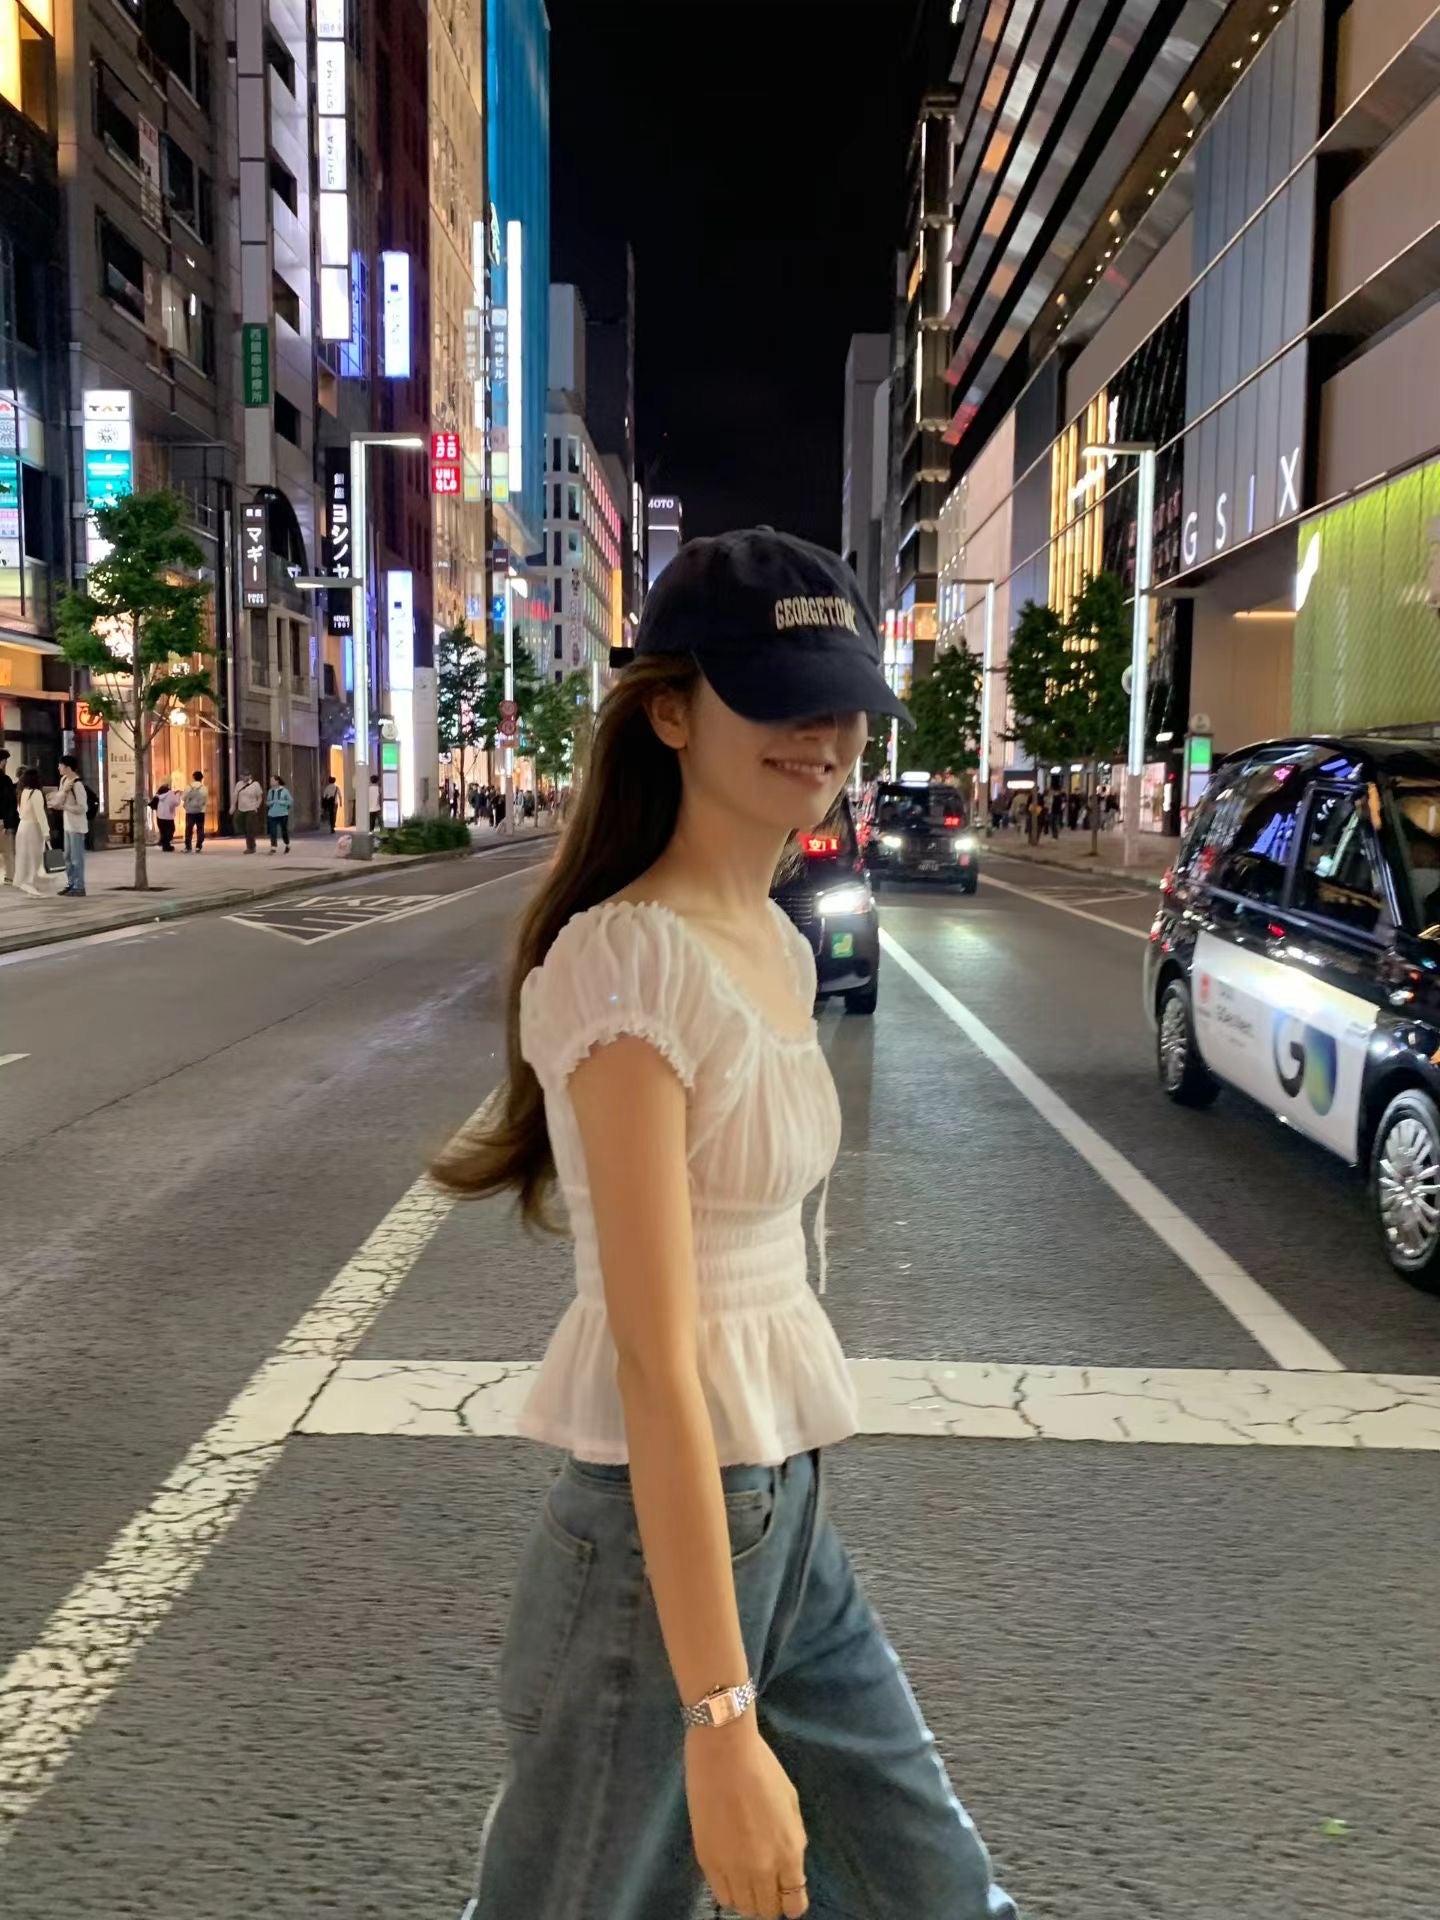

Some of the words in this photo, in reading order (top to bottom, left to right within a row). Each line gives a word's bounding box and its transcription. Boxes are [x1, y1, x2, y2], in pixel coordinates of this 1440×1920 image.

[436, 469, 455, 480] UNI
[436, 480, 457, 492] QLO
[247, 527, 264, 582] マギー
